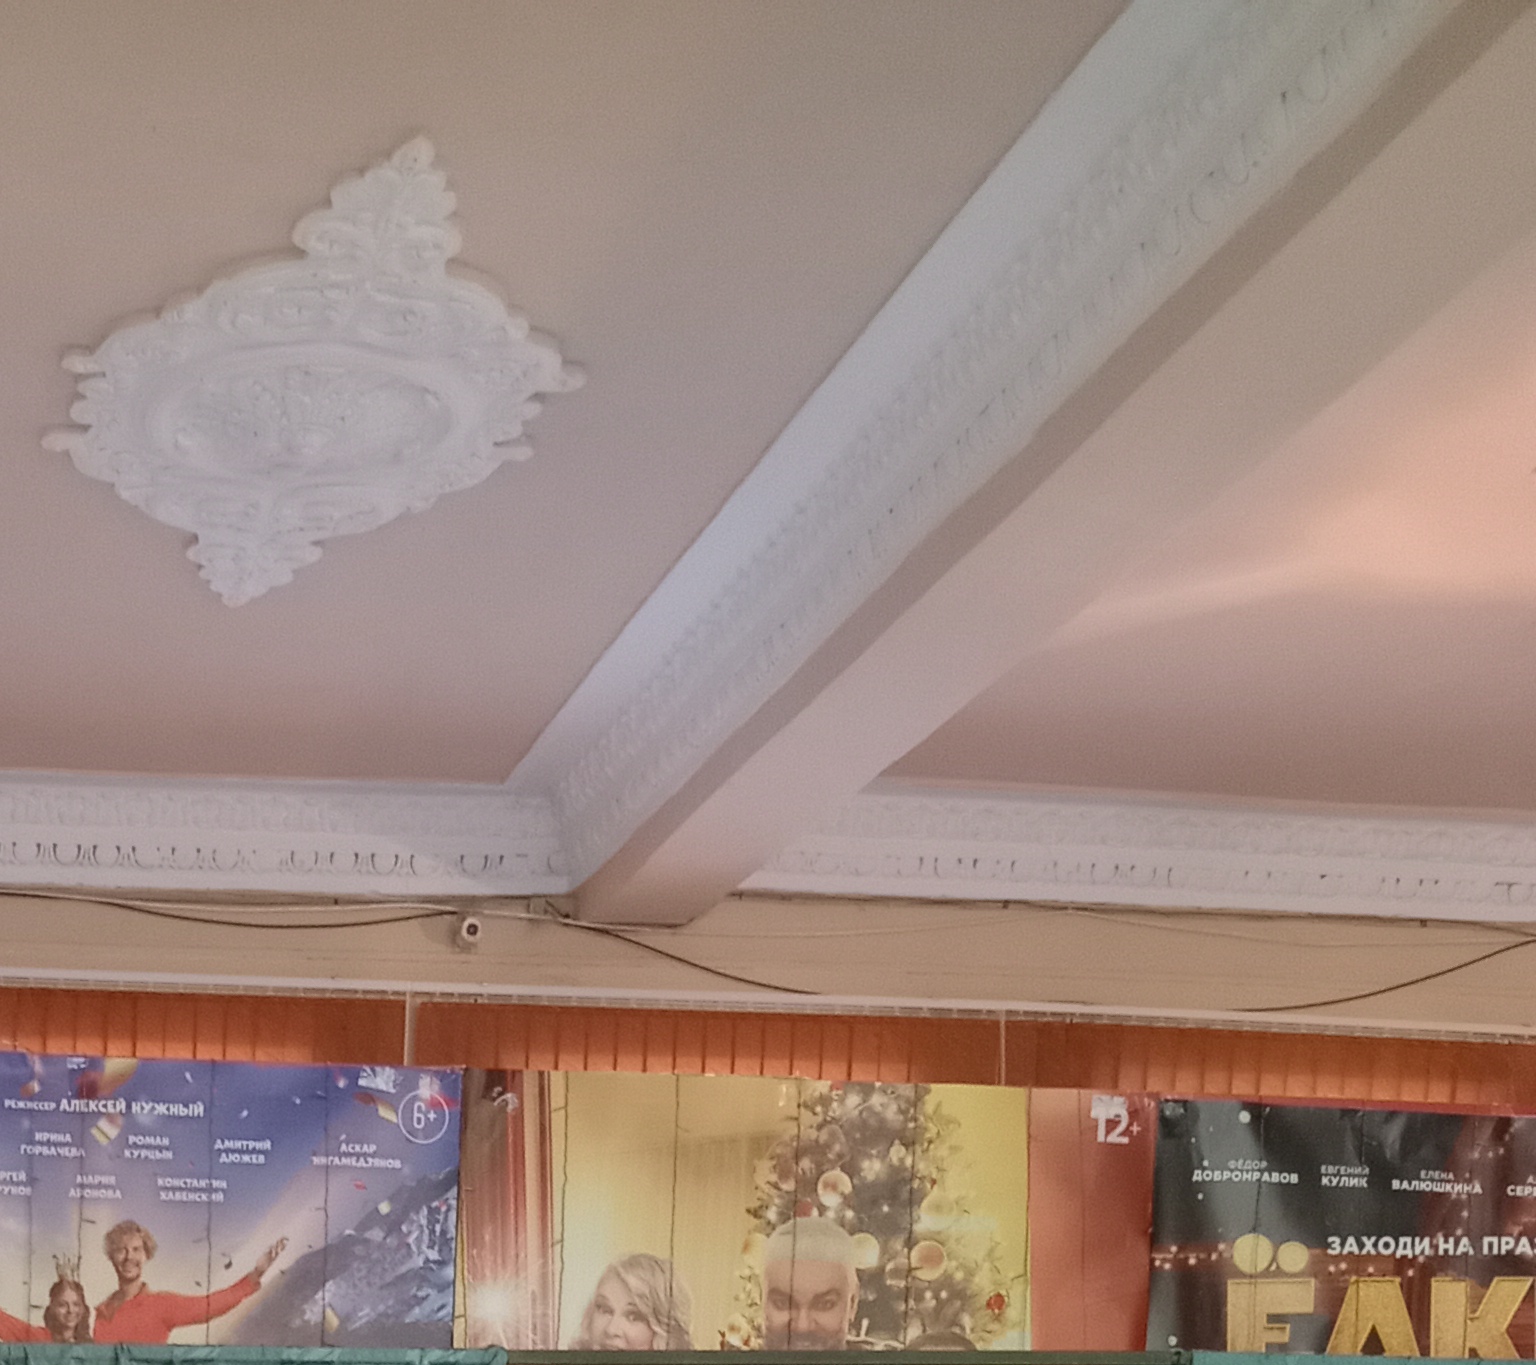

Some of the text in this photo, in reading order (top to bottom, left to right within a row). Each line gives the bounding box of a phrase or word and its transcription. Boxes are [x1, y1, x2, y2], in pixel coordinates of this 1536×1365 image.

[4, 1097, 205, 1118] РЕЖИССЕР АЛЕКСЕЙ НУЖНЫЙ
[412, 1100, 438, 1130] 6+
[1091, 1107, 1142, 1145] 12+
[35, 1131, 72, 1143] ИРИНА
[128, 1134, 170, 1147] РОМАН
[214, 1137, 272, 1151] ДМИТРИЙ
[123, 1148, 173, 1161] КУРЦЫН
[339, 1142, 378, 1155] АСКАР
[219, 1151, 266, 1165] ДЮЖЕВ
[1227, 1157, 1268, 1170] ФЁДОР
[1320, 1163, 1371, 1176] ЕВГЕНИЙ
[1420, 1168, 1456, 1181] ЕЛЕНА
[1192, 1169, 1300, 1185] ДОБРОНРАВОВ
[1321, 1175, 1368, 1189] КУЛИК
[1391, 1177, 1484, 1195] ВАЛЮШКИНА
[1326, 1235, 1536, 1259] ЗАХОДИ НА ПРА
[1226, 1233, 1536, 1359] ЁЛК
